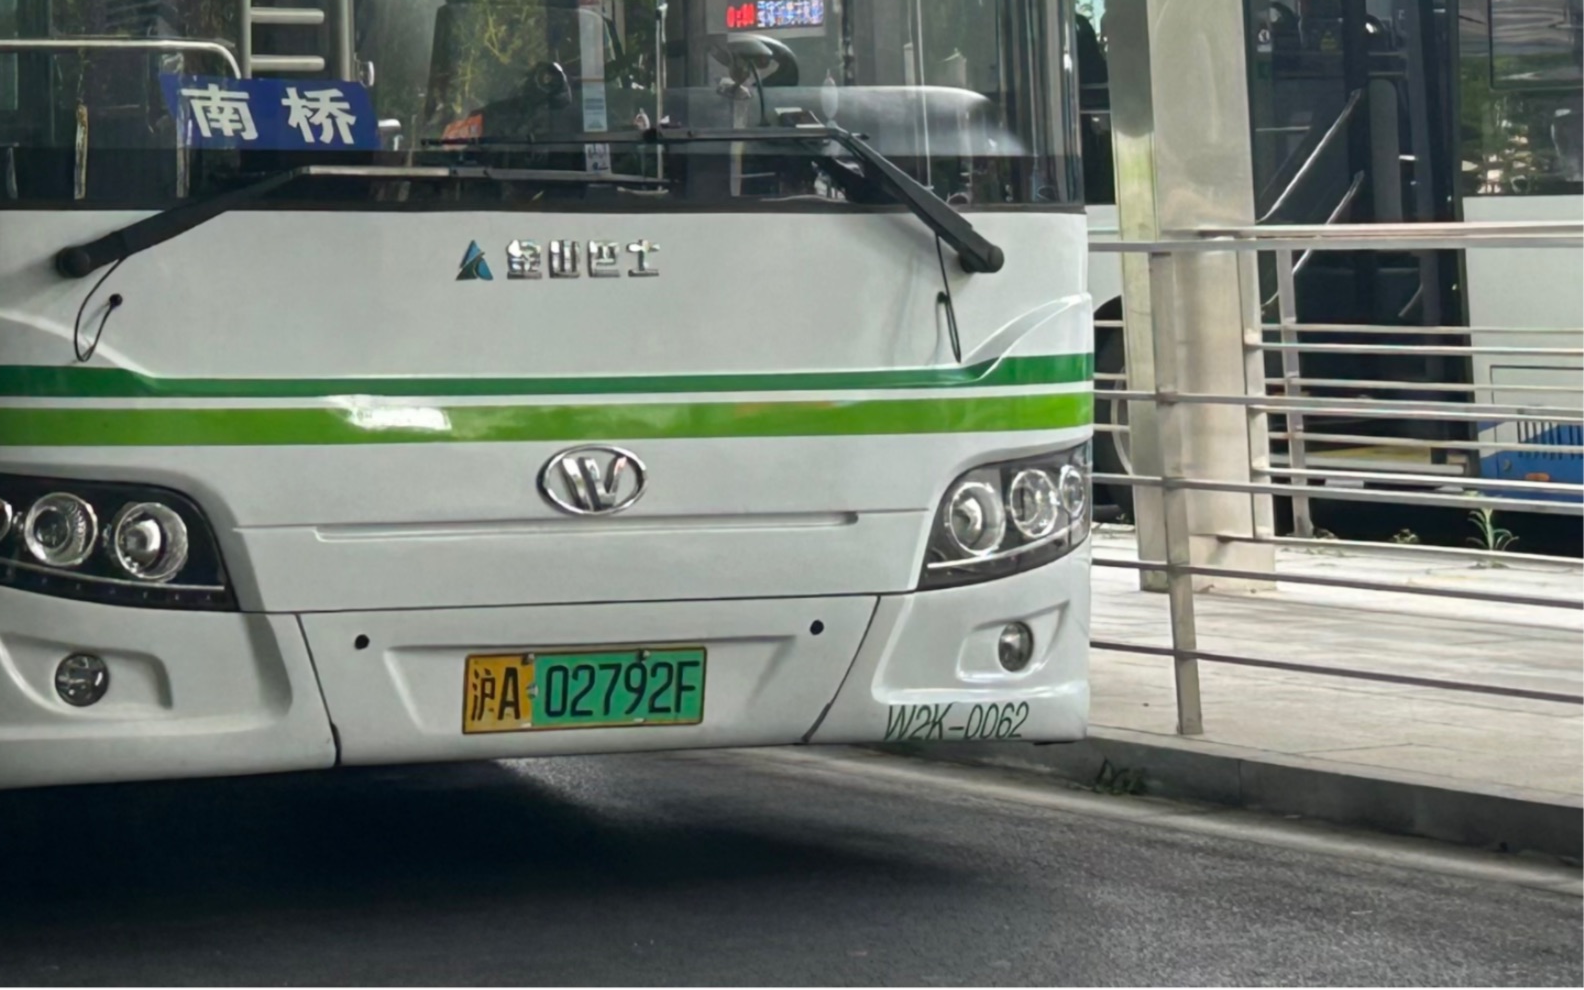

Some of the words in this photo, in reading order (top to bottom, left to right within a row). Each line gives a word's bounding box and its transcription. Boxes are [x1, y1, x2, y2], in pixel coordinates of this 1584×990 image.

[181, 83, 356, 145] 南桥
[471, 666, 521, 722] 沪A
[543, 660, 701, 718] 02792F
[883, 700, 1030, 741] W2K-0062
